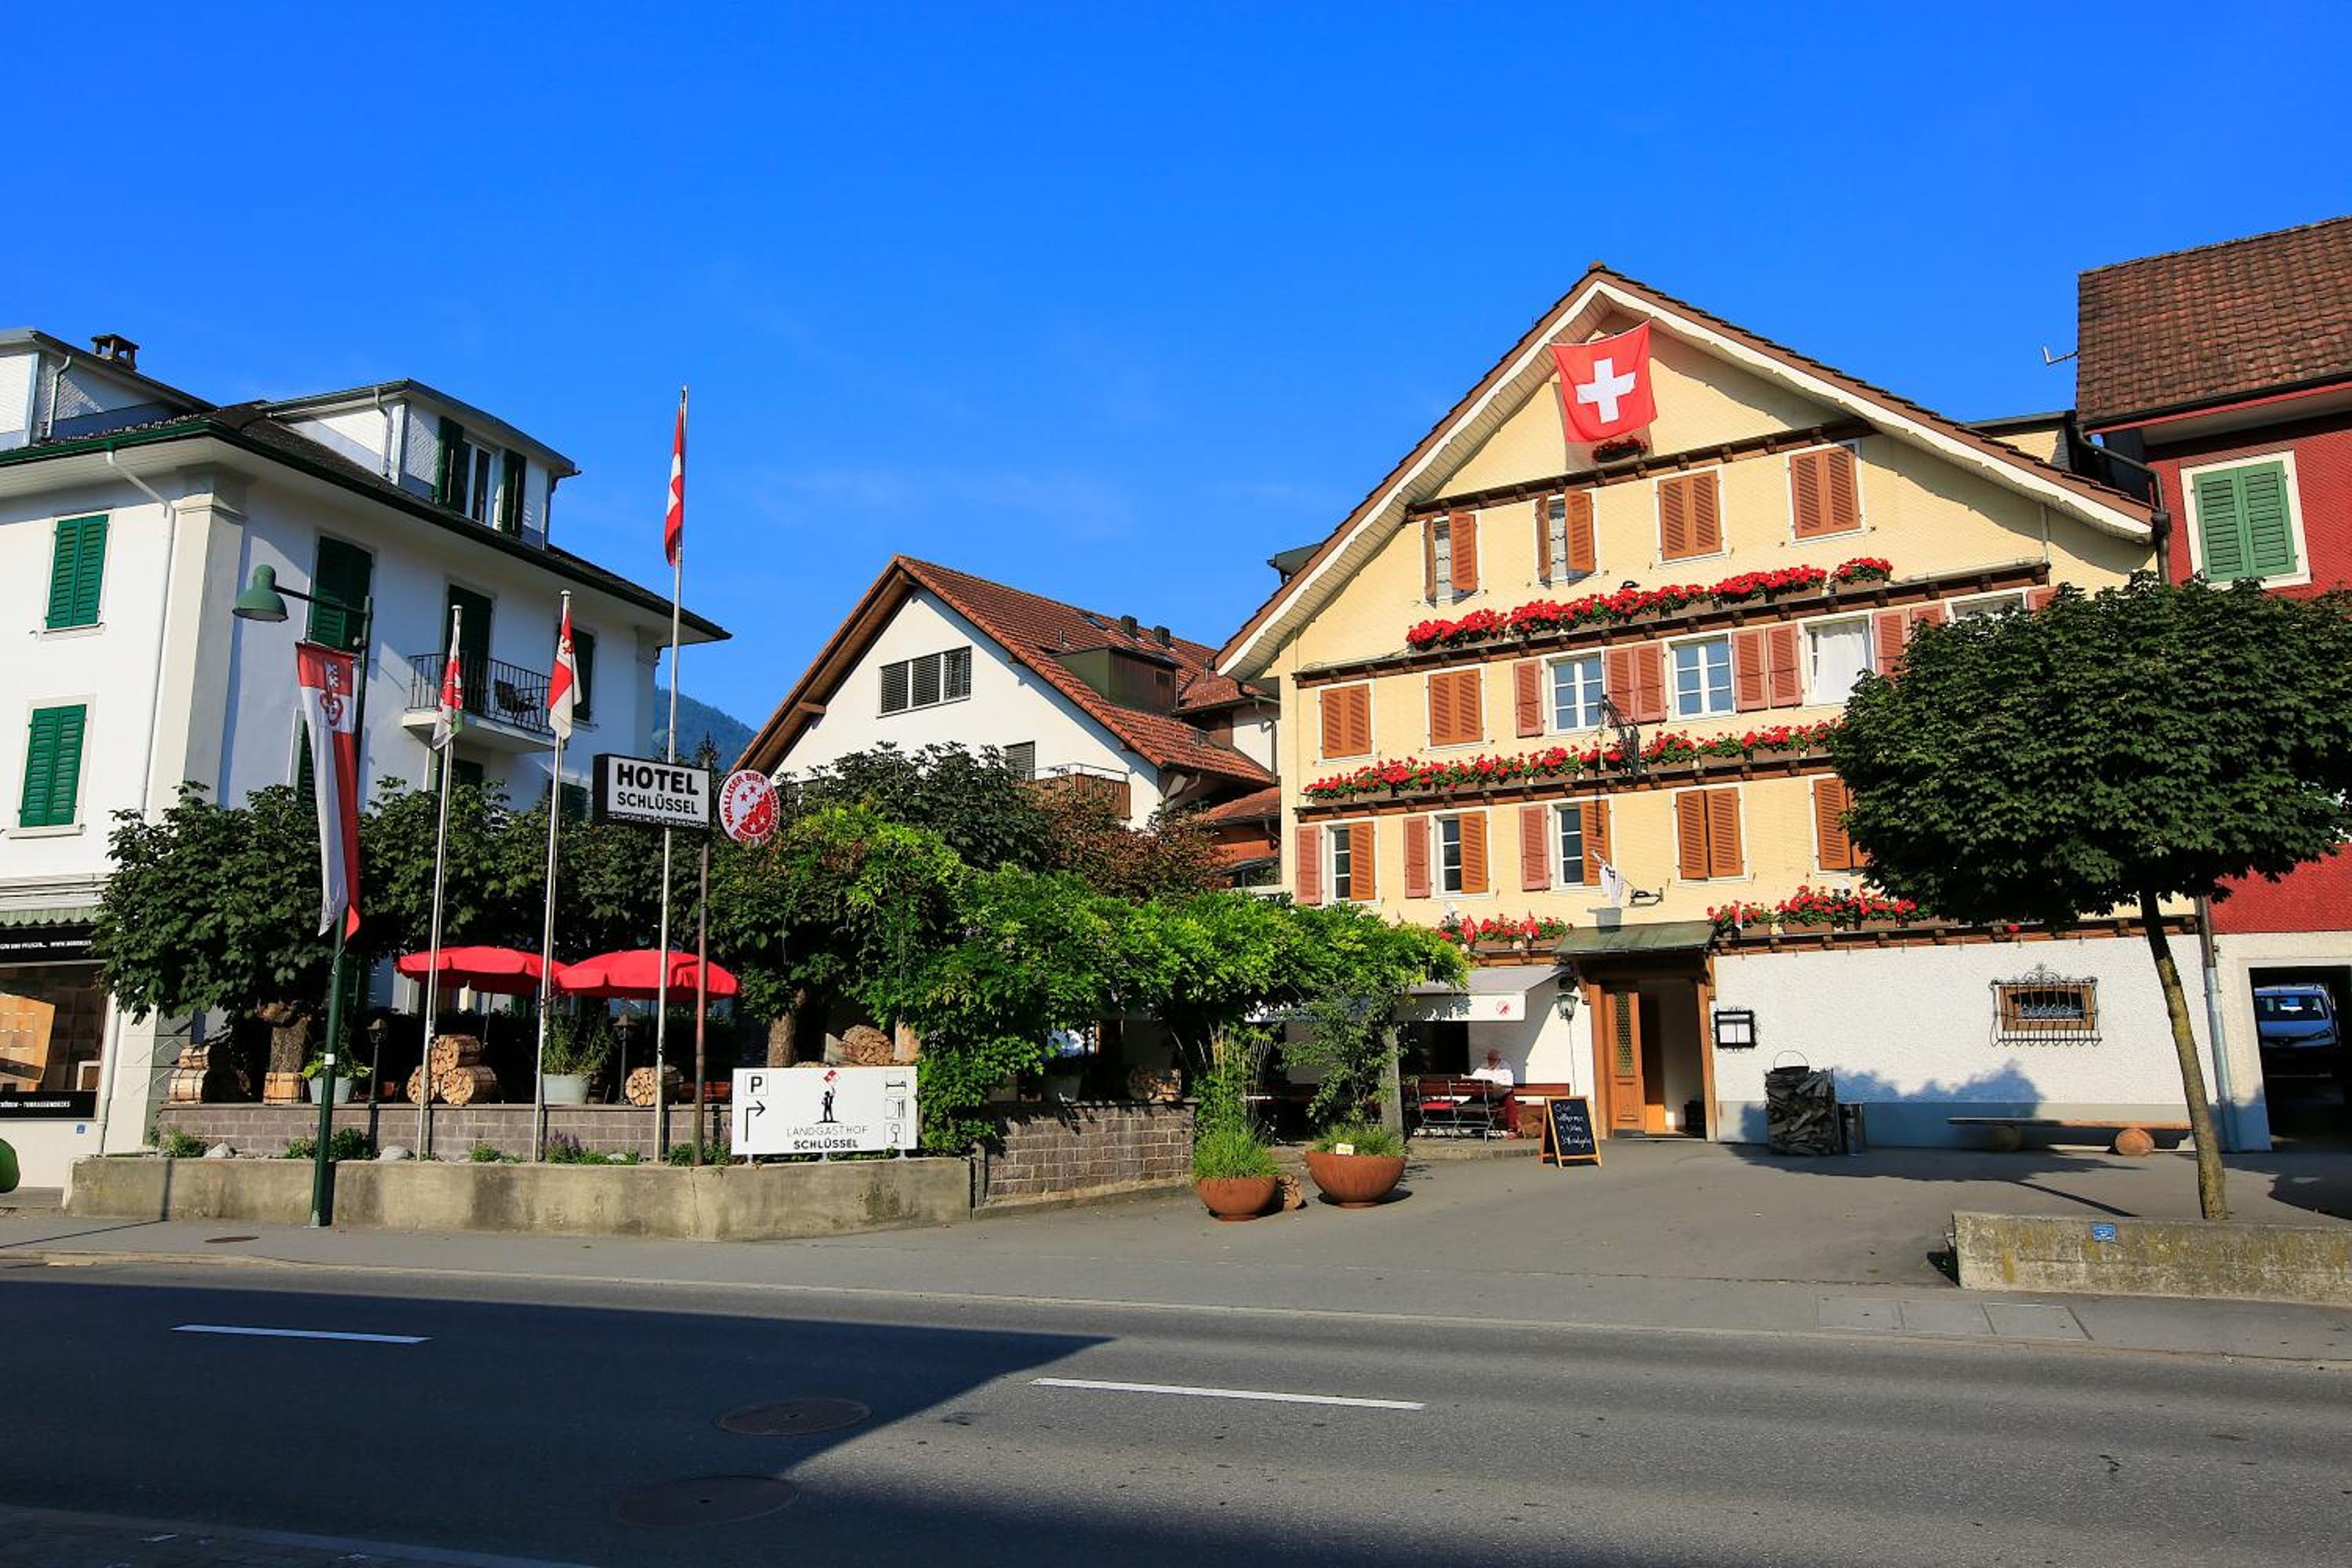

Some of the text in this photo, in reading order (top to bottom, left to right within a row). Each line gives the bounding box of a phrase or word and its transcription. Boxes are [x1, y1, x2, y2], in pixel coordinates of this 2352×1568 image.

[617, 763, 699, 796] HOTEL
[617, 791, 699, 815] SCHLÜSSEL
[724, 773, 766, 828] WALLISER BIER
[750, 1076, 763, 1093] P
[786, 1125, 869, 1138] LANDGASTHOF
[793, 1138, 859, 1150] SCHLÜSSEL
